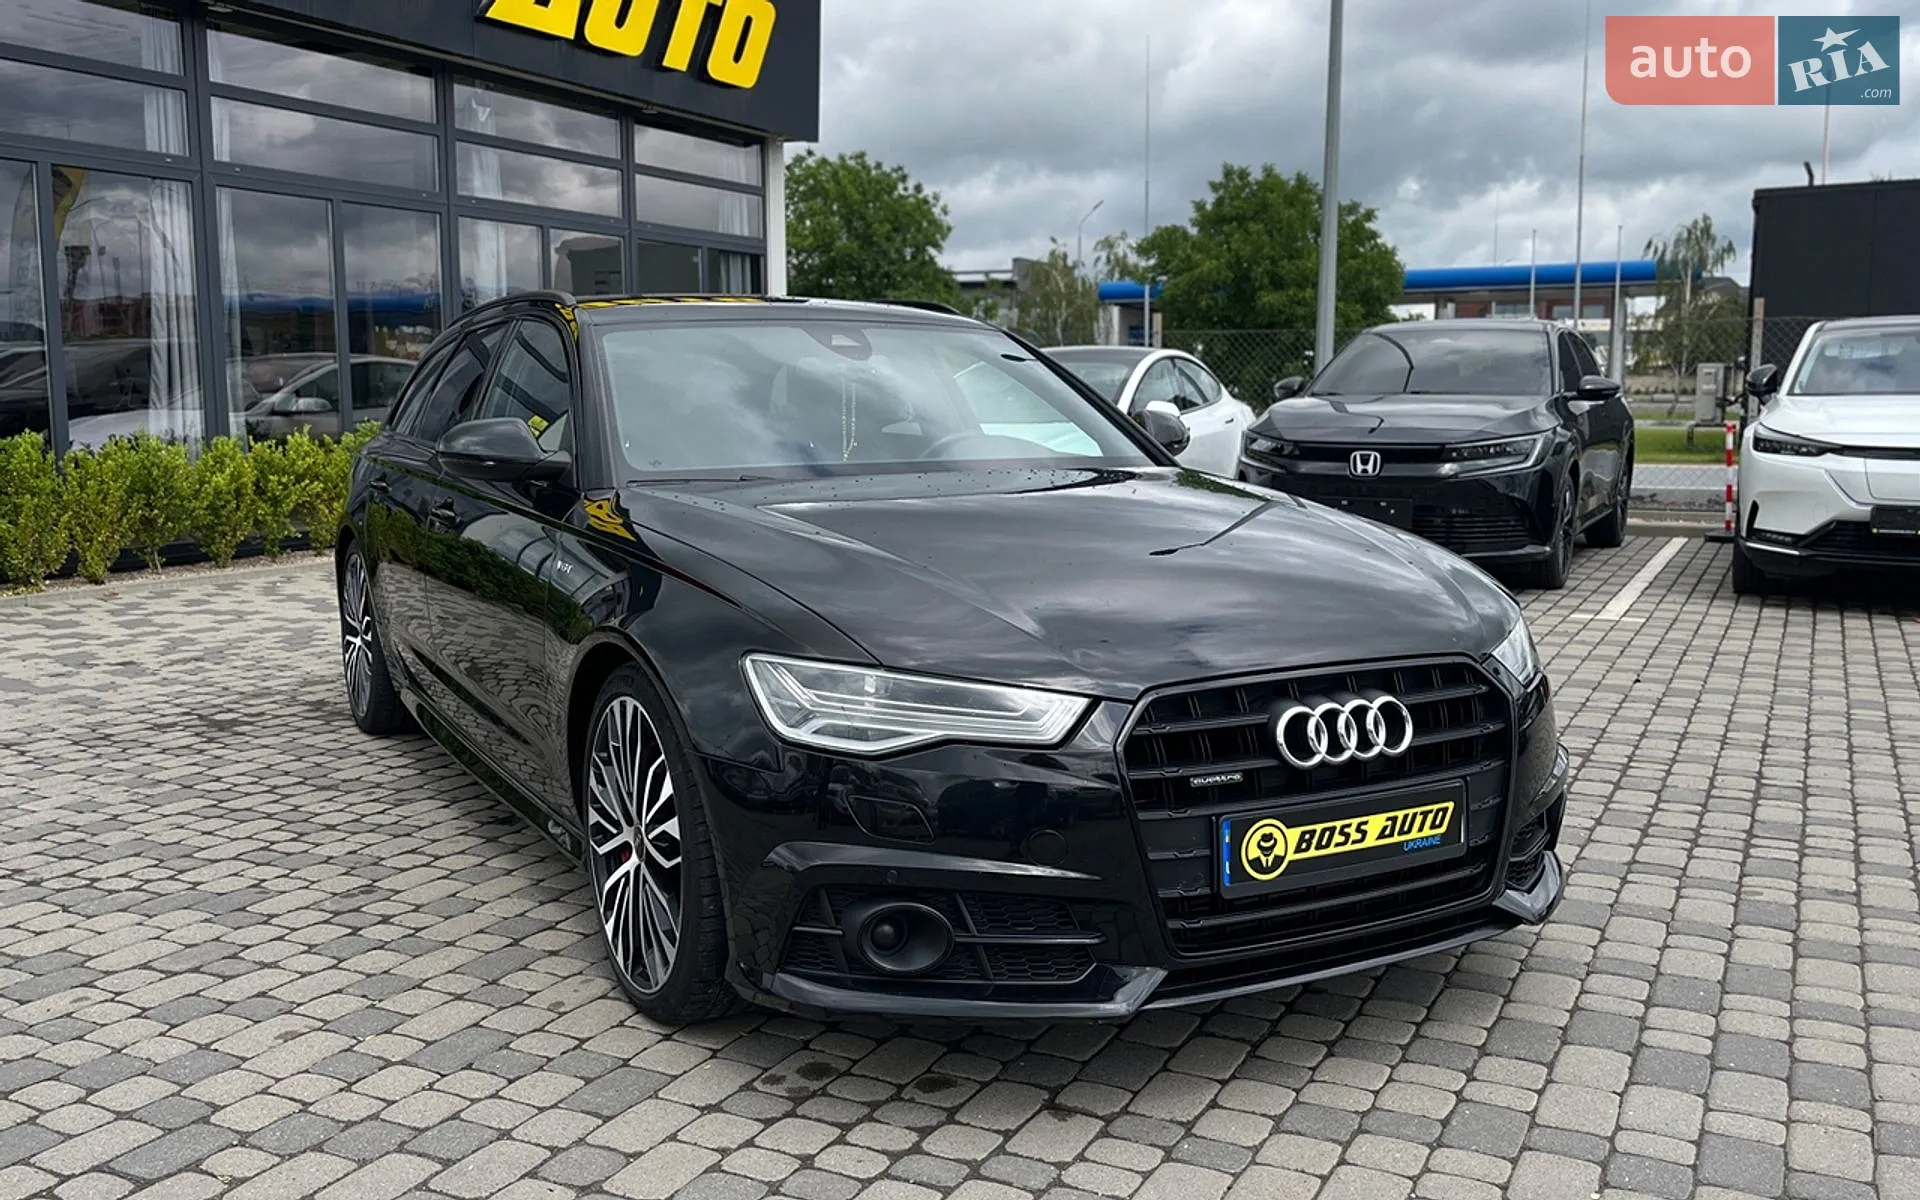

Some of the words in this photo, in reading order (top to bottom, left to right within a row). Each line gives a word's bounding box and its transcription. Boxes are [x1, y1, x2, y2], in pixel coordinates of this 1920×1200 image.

[1293, 820, 1369, 855] BOSS
[1375, 805, 1450, 841] AUTO
[1403, 835, 1441, 852] UKRAINE
